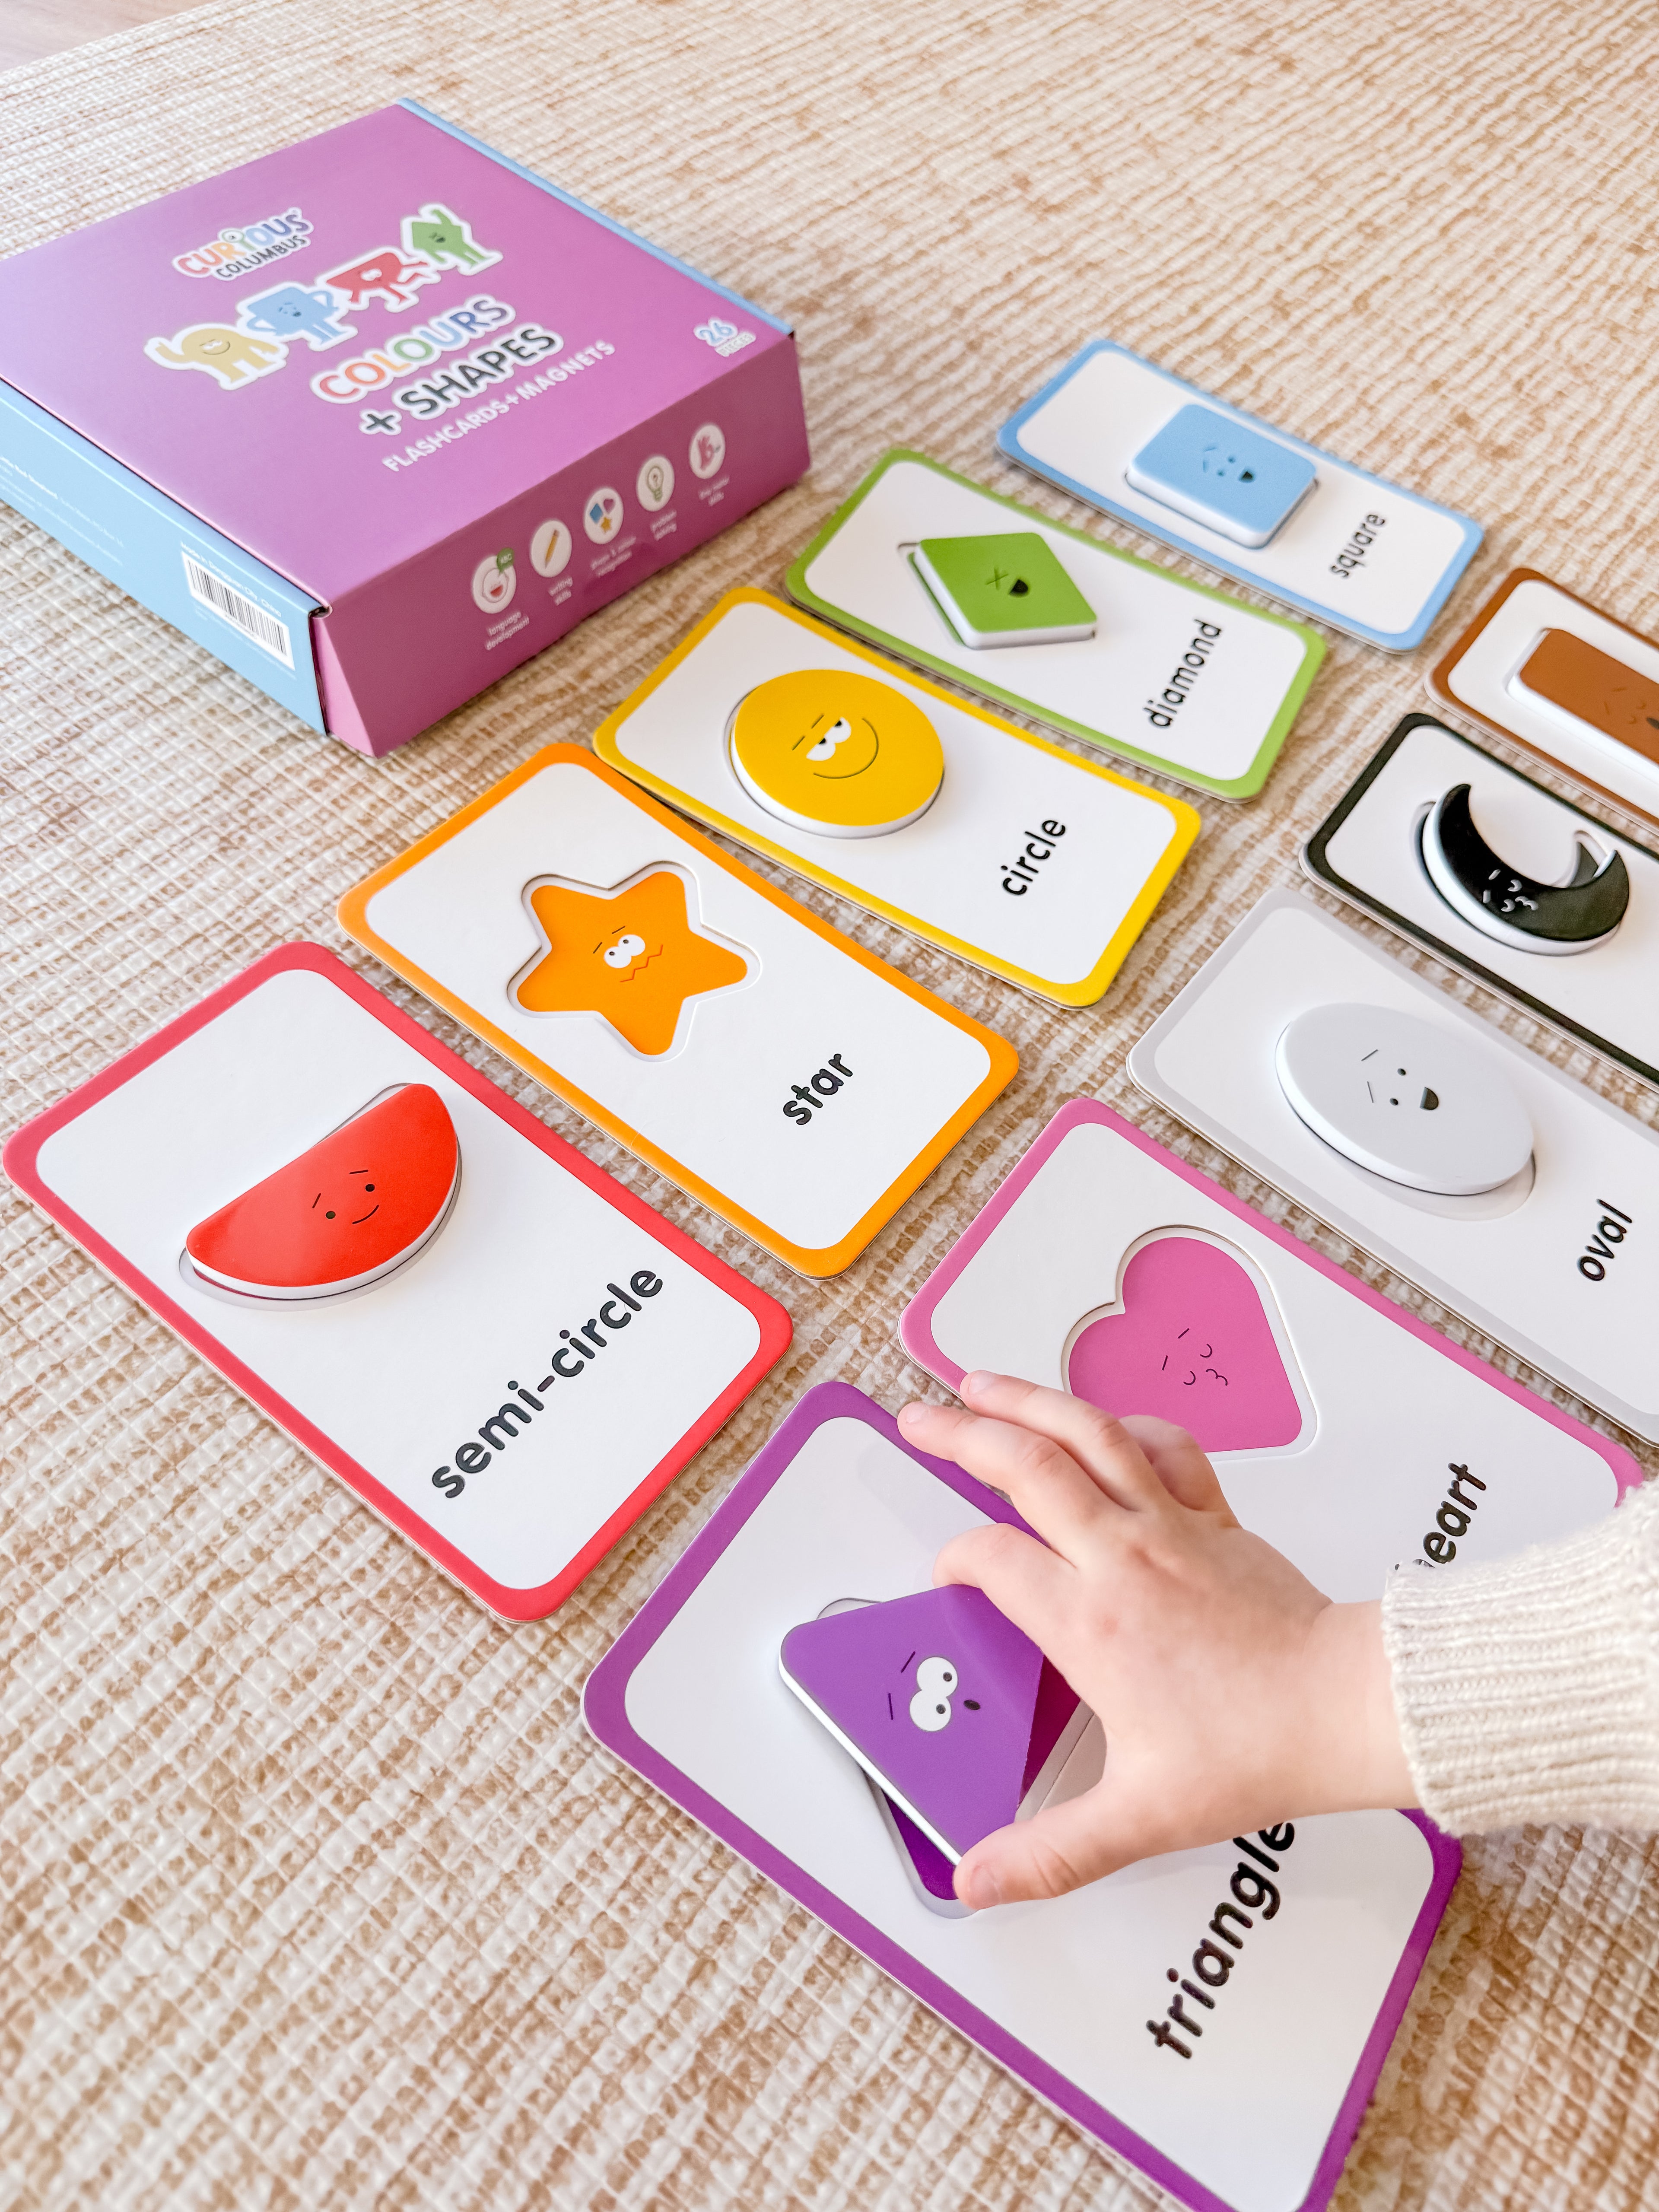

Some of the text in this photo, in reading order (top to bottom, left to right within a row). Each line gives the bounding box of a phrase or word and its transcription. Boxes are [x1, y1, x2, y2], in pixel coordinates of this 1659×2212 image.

[216, 235, 306, 278] COLUMBUS
[319, 299, 507, 398] COLOURS
[400, 328, 556, 415] SHAPES
[699, 322, 733, 342] 26
[1329, 513, 1386, 578] square
[487, 611, 521, 636] language
[1143, 619, 1222, 728] diamond
[1001, 820, 1066, 896] circle
[783, 1053, 853, 1125] star
[1577, 1198, 1633, 1282] oval
[432, 1270, 663, 1499] semi-circle
[1395, 1462, 1487, 1570] eart
[1146, 1822, 1295, 2059] triangle
